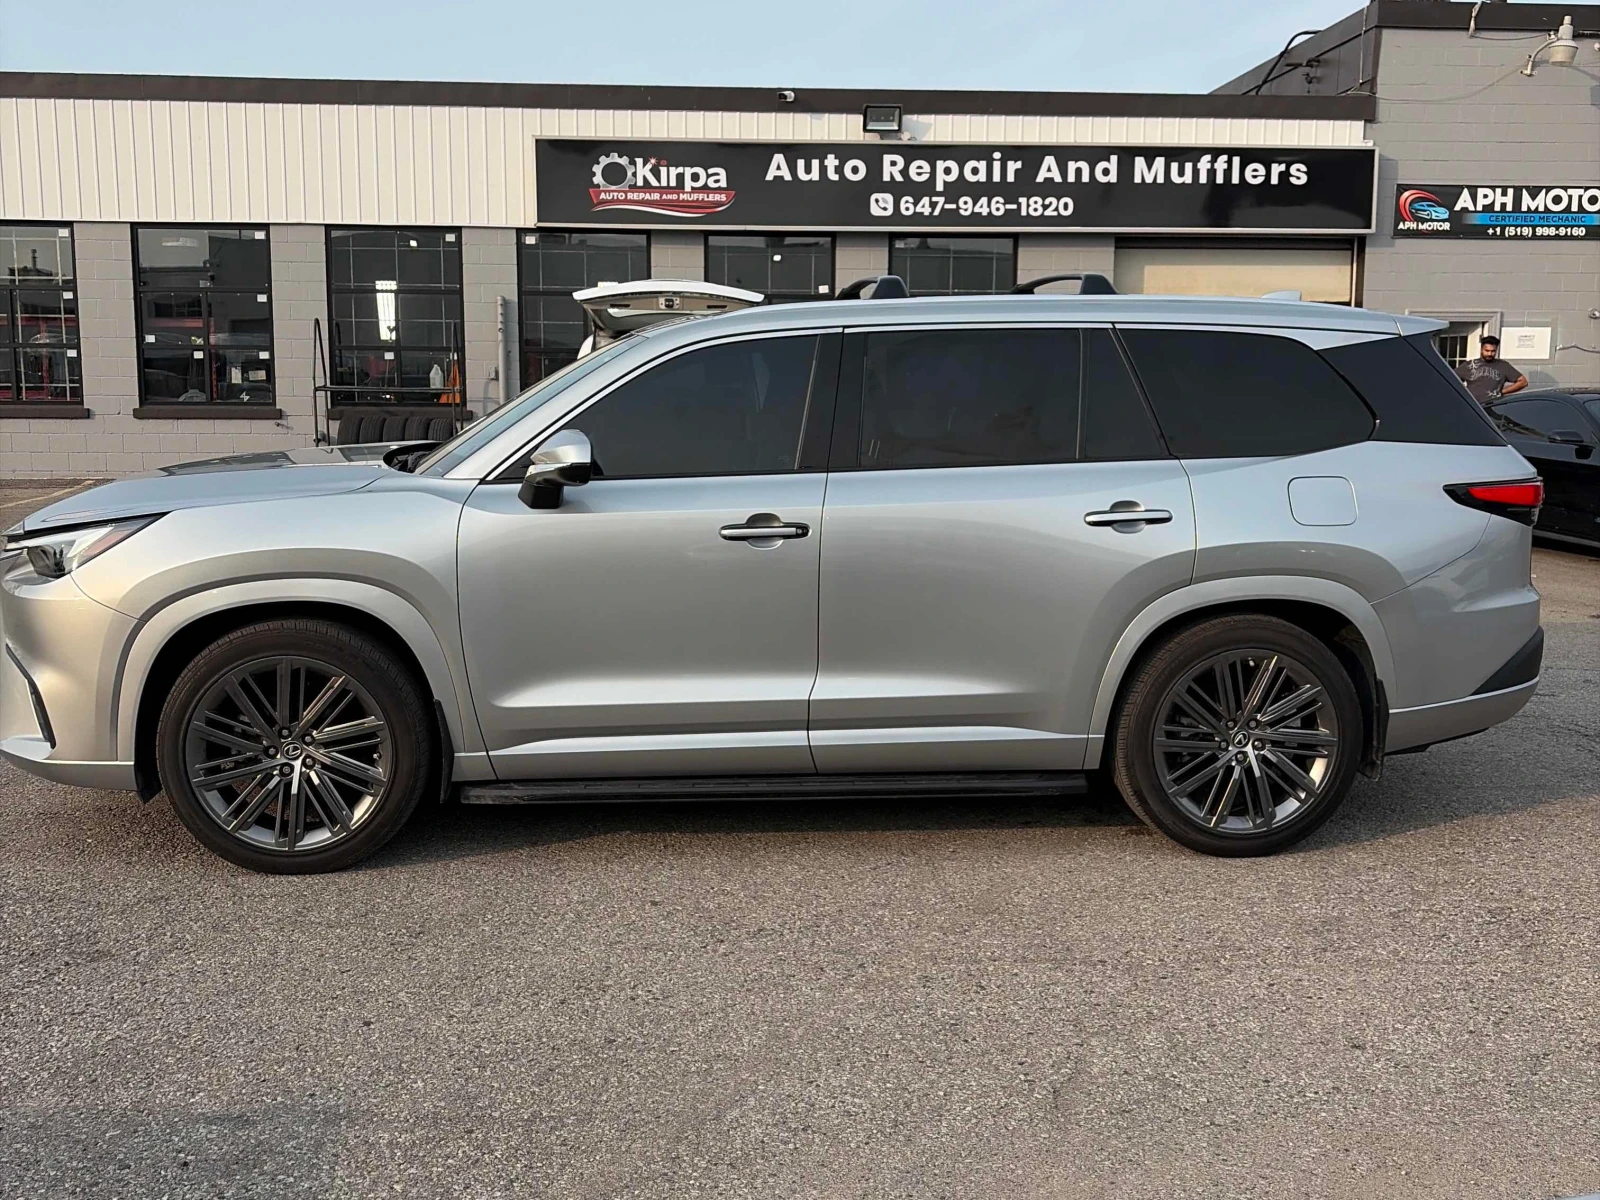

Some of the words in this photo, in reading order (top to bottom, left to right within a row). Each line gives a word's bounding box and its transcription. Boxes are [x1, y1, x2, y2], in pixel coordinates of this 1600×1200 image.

[635, 157, 728, 191] Kirpa
[765, 153, 867, 182] Auto
[883, 152, 1023, 191] Repair
[1036, 154, 1118, 184] And
[1134, 155, 1309, 185] Mufflers
[599, 192, 626, 200] AUTO
[627, 193, 661, 201] REPAIR
[680, 193, 727, 202] MUFFLERS
[1454, 187, 1514, 212] APH
[900, 196, 1075, 217] 647-946-1820
[1397, 222, 1417, 230] APH
[1418, 222, 1451, 231] MOTOR
[1489, 215, 1535, 223] CERTIFIED
[1538, 215, 1586, 223] MECHANIC
[1487, 227, 1500, 236] +1
[1505, 226, 1533, 238] (519)
[1535, 227, 1586, 237] 998-9160
